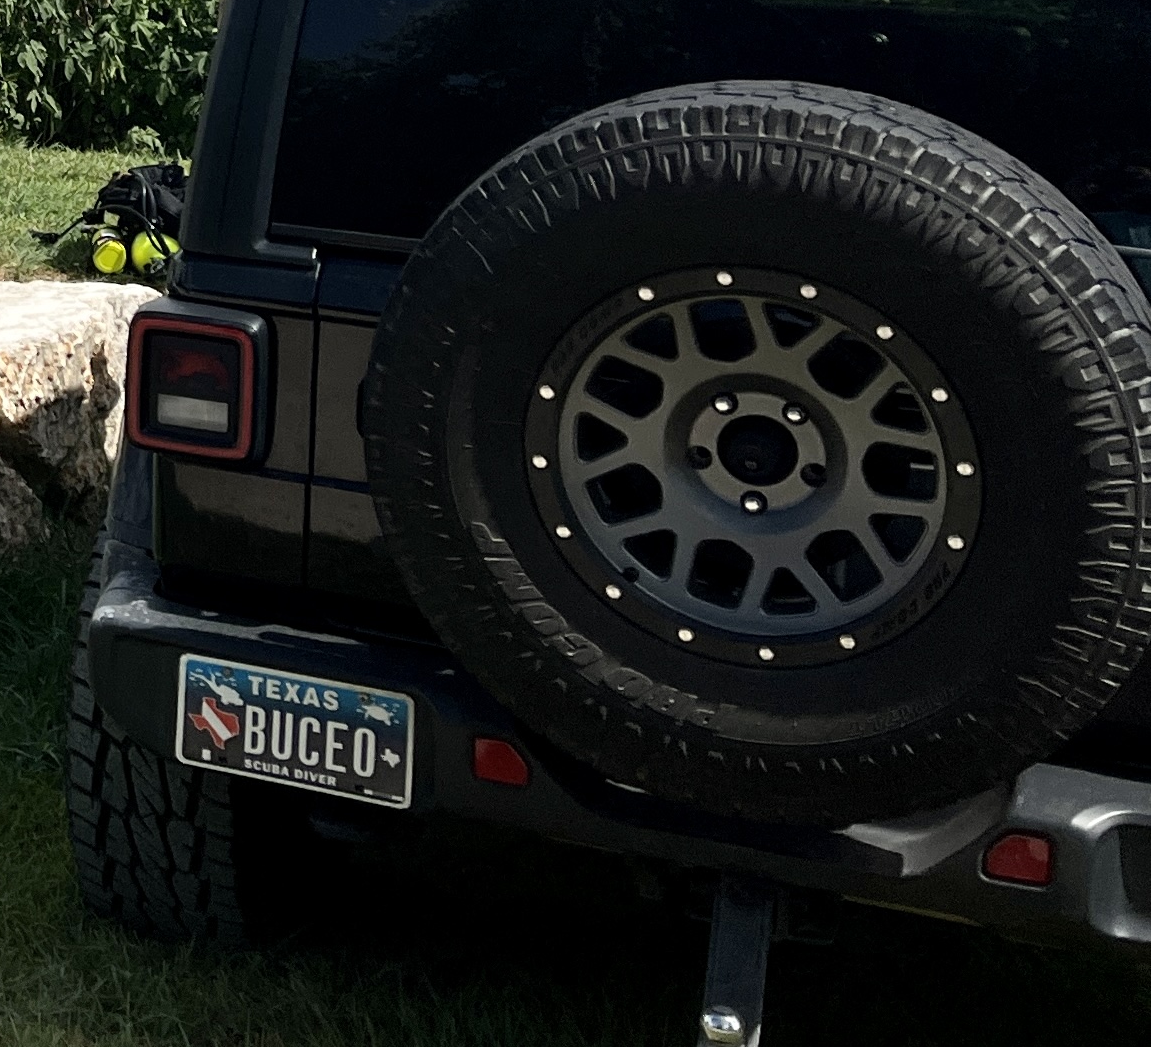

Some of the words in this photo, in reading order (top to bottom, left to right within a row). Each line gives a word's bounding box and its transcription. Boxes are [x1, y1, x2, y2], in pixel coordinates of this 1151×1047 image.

[248, 675, 340, 711] TEXAS
[244, 704, 376, 778] BUCEO
[244, 759, 289, 777] SCUBA
[294, 768, 337, 787] DIVER
